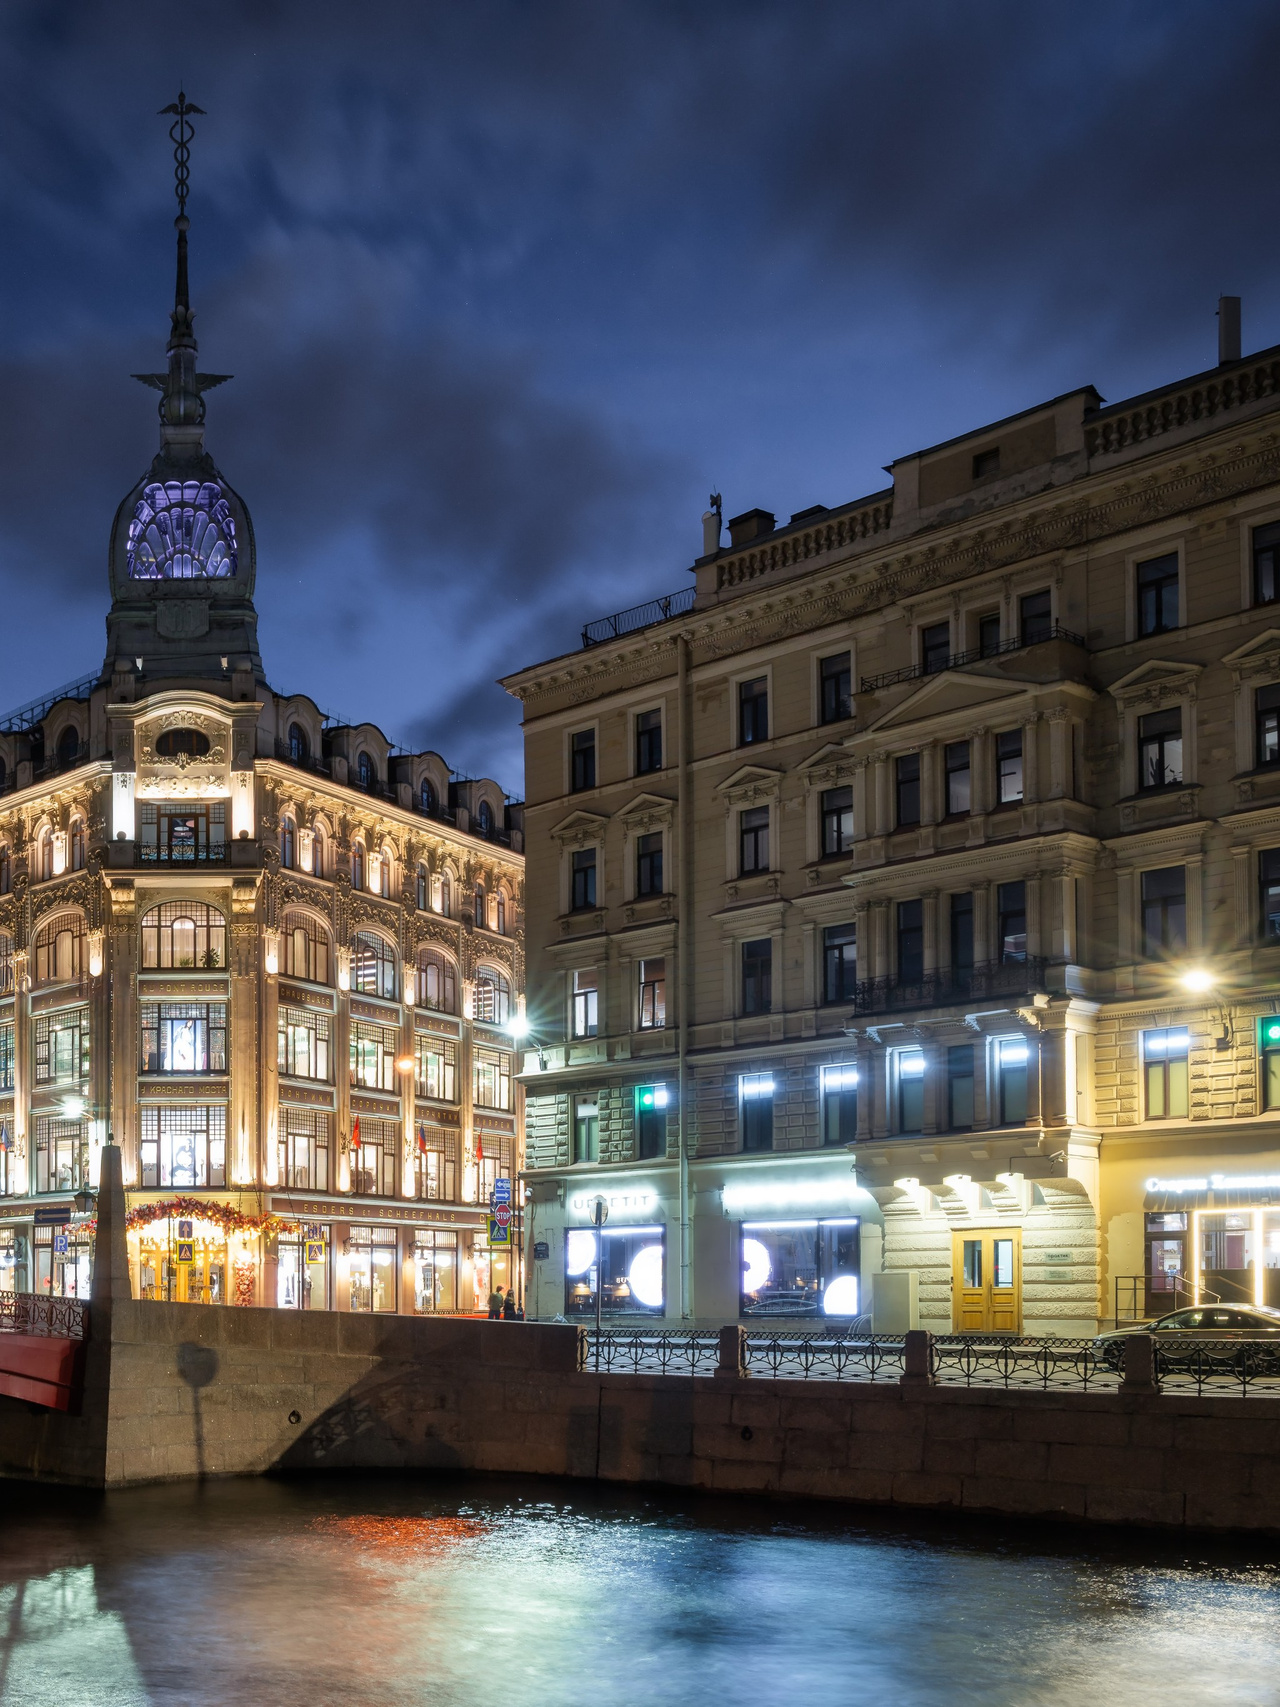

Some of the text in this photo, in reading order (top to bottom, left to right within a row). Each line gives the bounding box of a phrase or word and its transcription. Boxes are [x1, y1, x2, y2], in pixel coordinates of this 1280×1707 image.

[160, 984, 186, 992] PONT
[191, 984, 225, 992] ROUGE
[281, 988, 330, 1006] CHAUSSURES
[150, 1086, 195, 1094] КРАСНАГО
[199, 1086, 228, 1094] МОСТА
[280, 1088, 331, 1102] ЗОНТИКИ
[415, 1107, 458, 1120] ПЕРЧАТКИ
[303, 1203, 354, 1215] ESDERS
[379, 1209, 455, 1222] SCHEEFHALS
[496, 1212, 510, 1220] STOP
[58, 1237, 66, 1250] P
